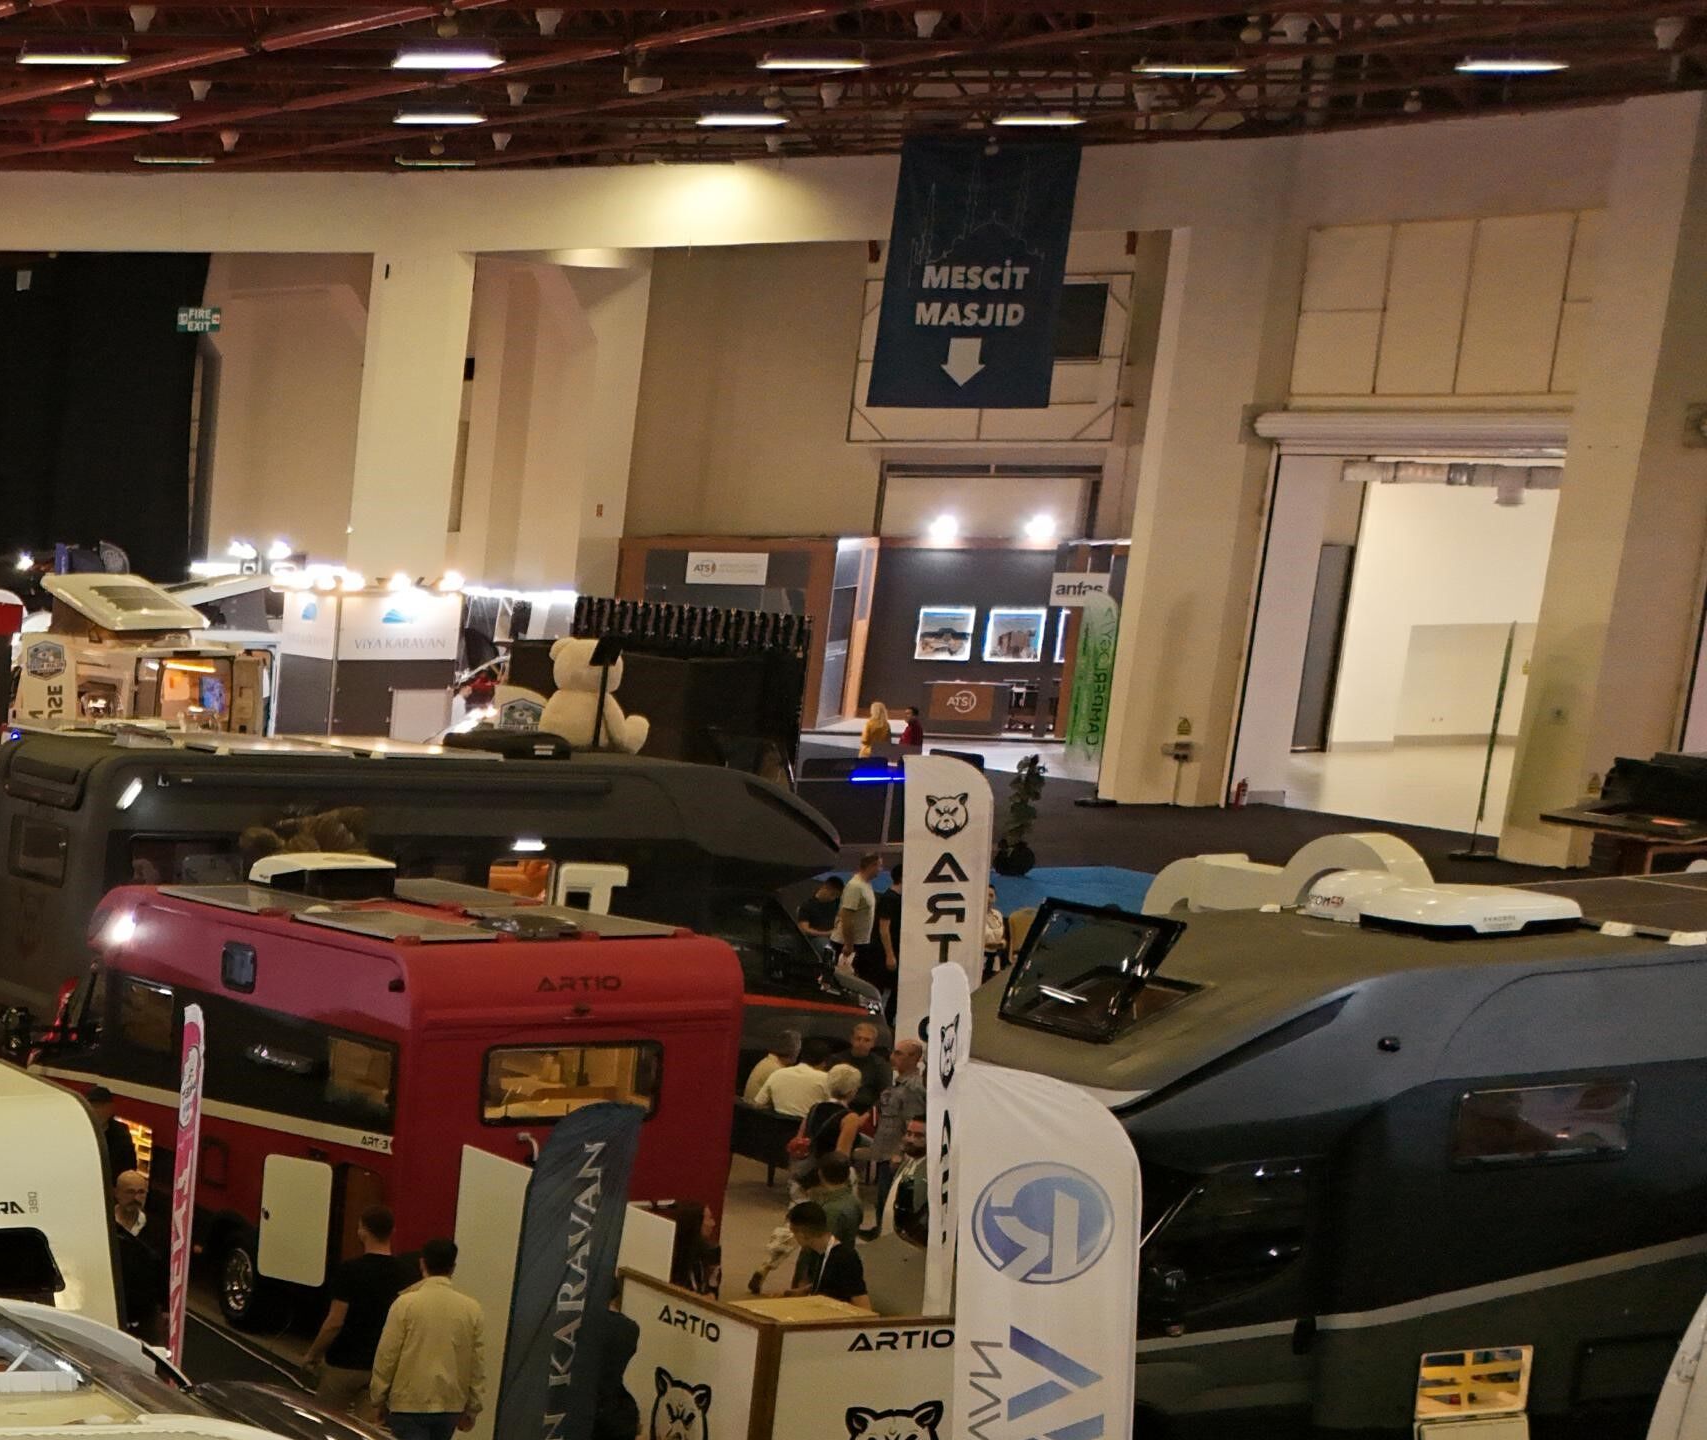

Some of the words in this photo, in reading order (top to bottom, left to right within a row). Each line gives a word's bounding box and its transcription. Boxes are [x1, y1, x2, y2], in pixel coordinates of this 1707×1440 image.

[921, 260, 1030, 290] MESCİT
[187, 321, 210, 332] EXIT
[188, 308, 212, 320] FIRE
[914, 302, 1025, 327] MASJID
[536, 975, 622, 992] ARTIO
[547, 1140, 605, 1387] KARAVAN
[657, 1303, 721, 1343] ARTIO
[846, 1328, 955, 1353] ARTIO
